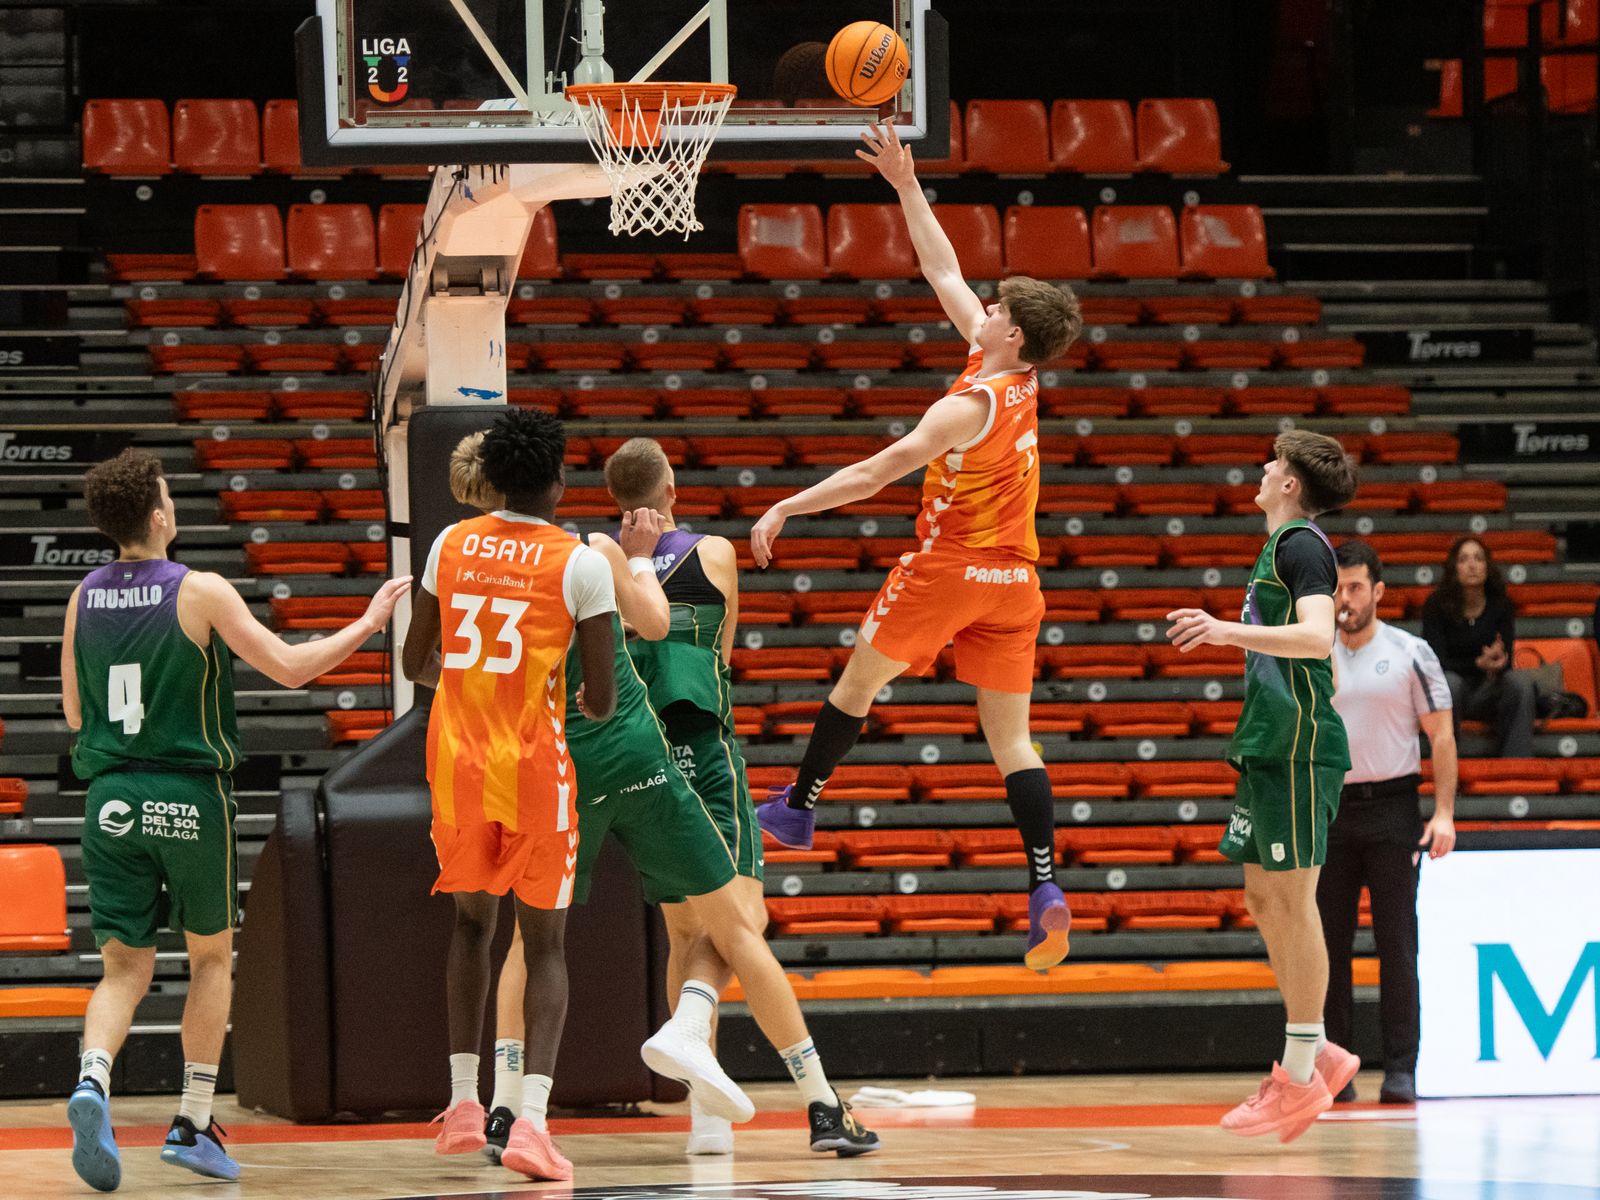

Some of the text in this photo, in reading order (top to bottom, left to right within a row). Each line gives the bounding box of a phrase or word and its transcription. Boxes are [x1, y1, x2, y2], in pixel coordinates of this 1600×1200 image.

[362, 38, 411, 55] LIGA
[859, 33, 892, 79] Wilson
[1408, 331, 1481, 360] Torres
[1513, 423, 1590, 453] Torres
[31, 535, 116, 565] Torres
[462, 533, 544, 567] OSAYI
[476, 571, 526, 589] CaixaBank
[86, 584, 163, 609] TRUJILLO
[443, 592, 531, 674] 33
[108, 663, 145, 735] 4
[142, 801, 201, 818] COSTA
[142, 814, 201, 830] DEL SOL
[142, 826, 199, 841] MÁLAGA
